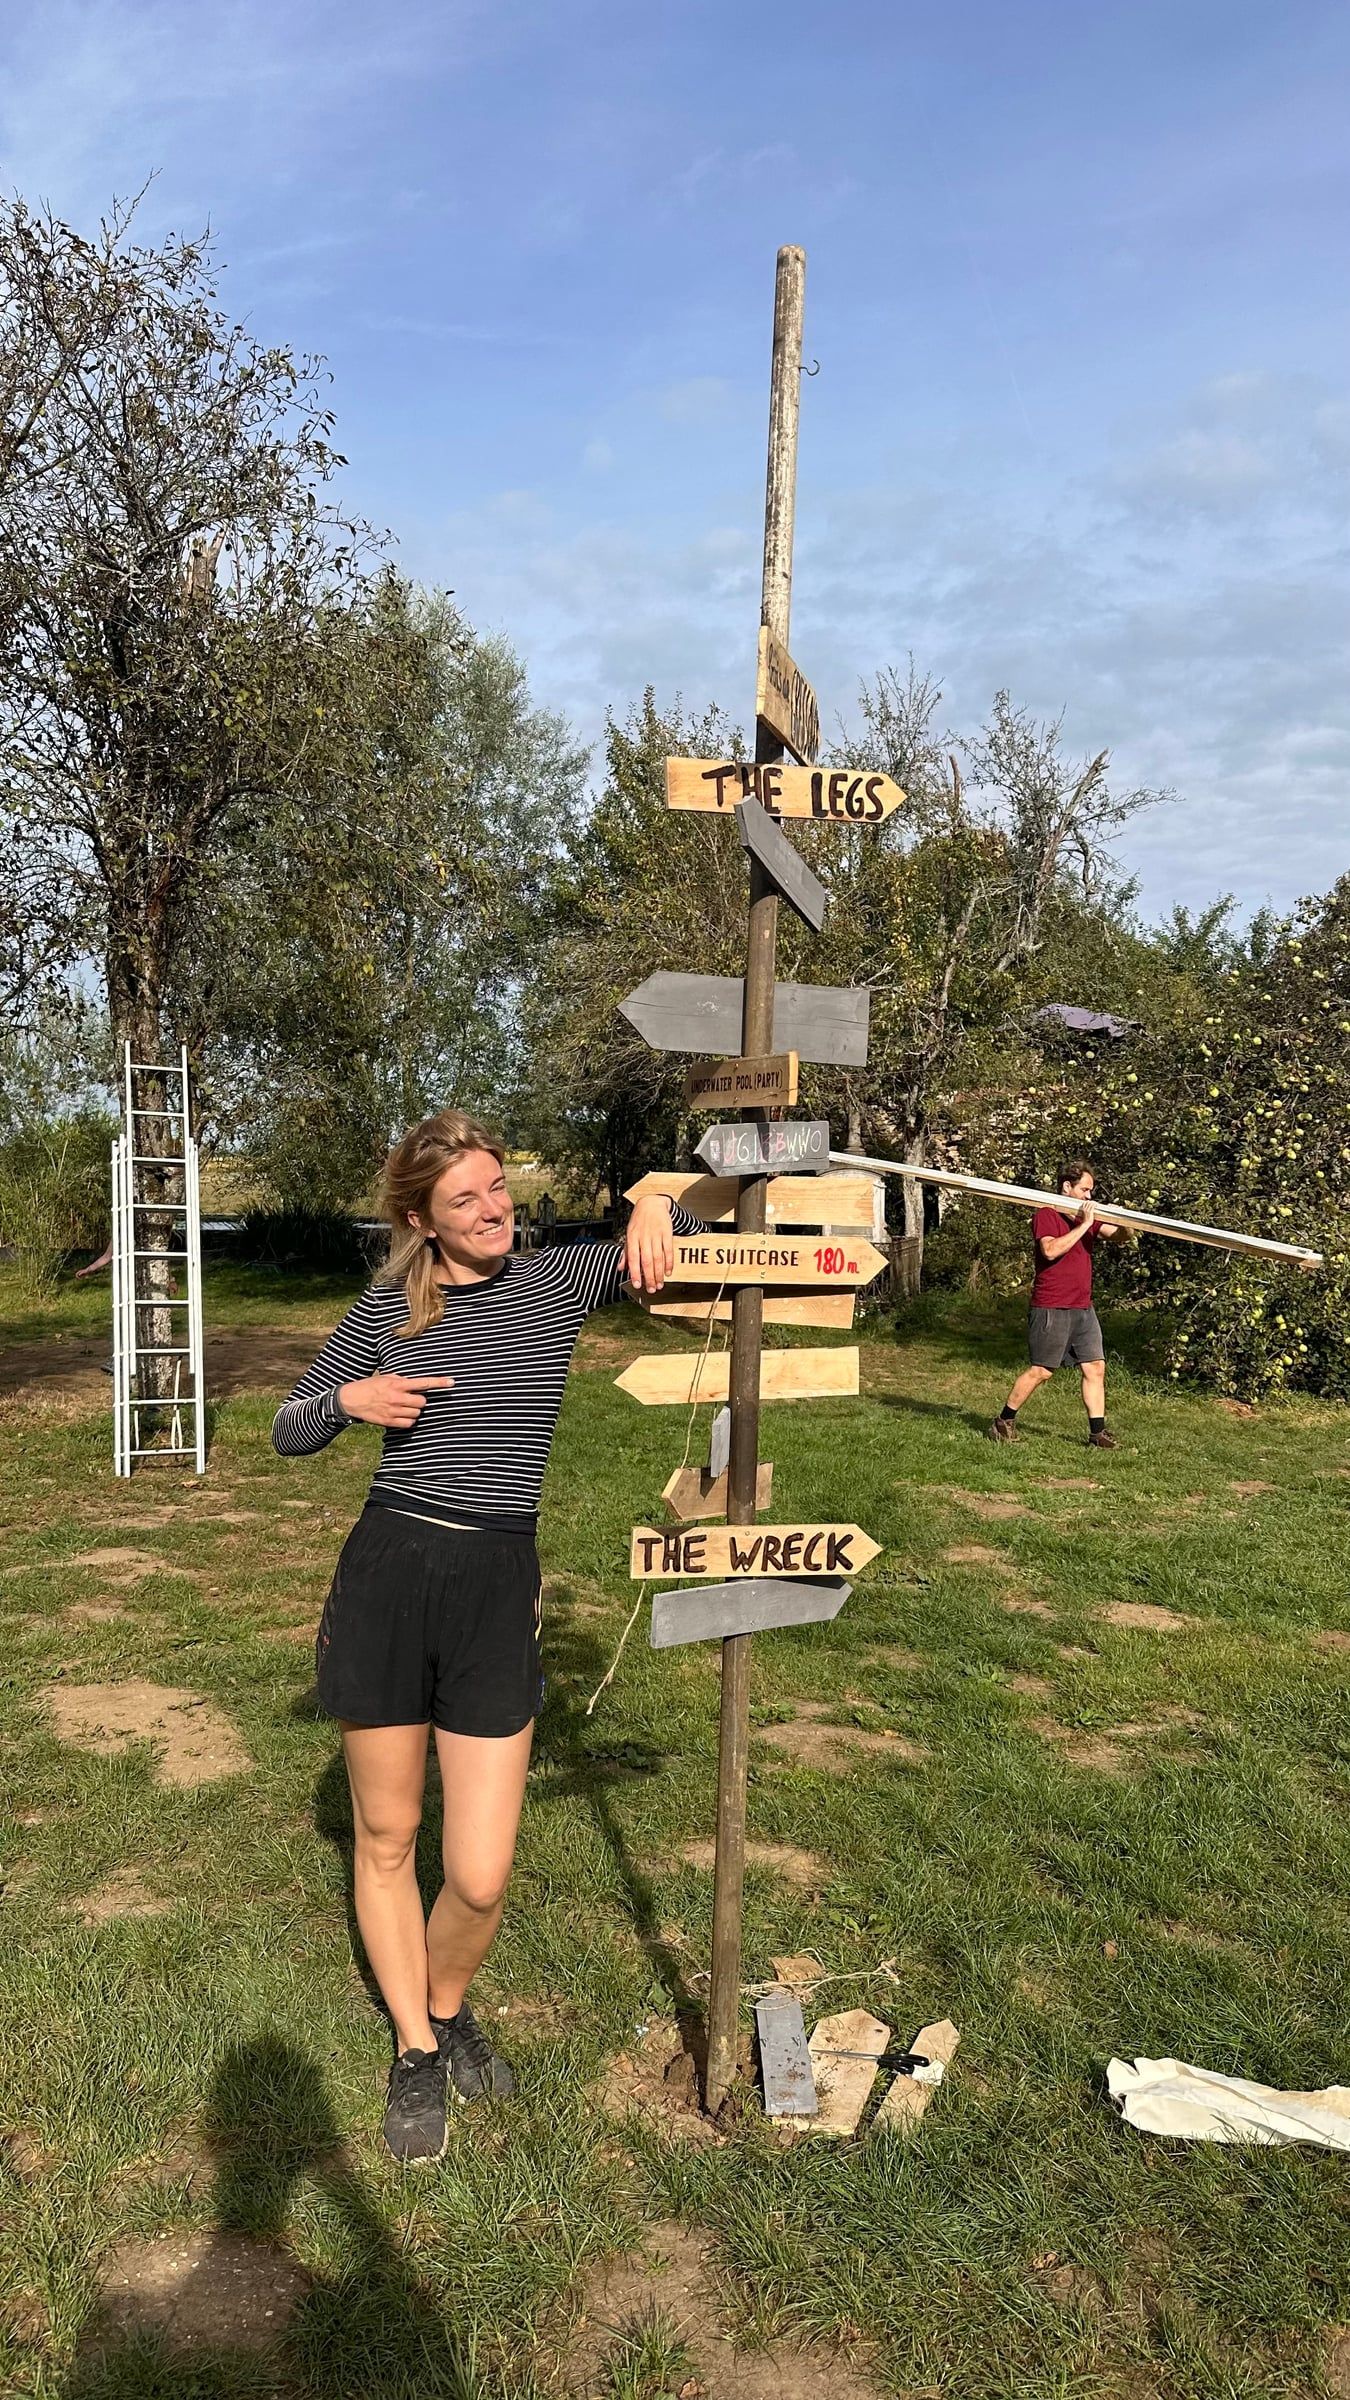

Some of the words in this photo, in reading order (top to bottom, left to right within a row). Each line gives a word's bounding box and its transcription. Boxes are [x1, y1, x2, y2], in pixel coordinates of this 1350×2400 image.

[701, 764, 783, 815] THE
[811, 772, 884, 821] LEGS
[691, 1076, 732, 1094] UNDERWATER
[735, 1074, 752, 1091] POOL
[754, 1067, 783, 1091] (PARTY)
[678, 1247, 710, 1265] THE
[716, 1248, 799, 1267] SUITCASE
[637, 1534, 707, 1573] THE
[729, 1532, 854, 1573] WRECK
